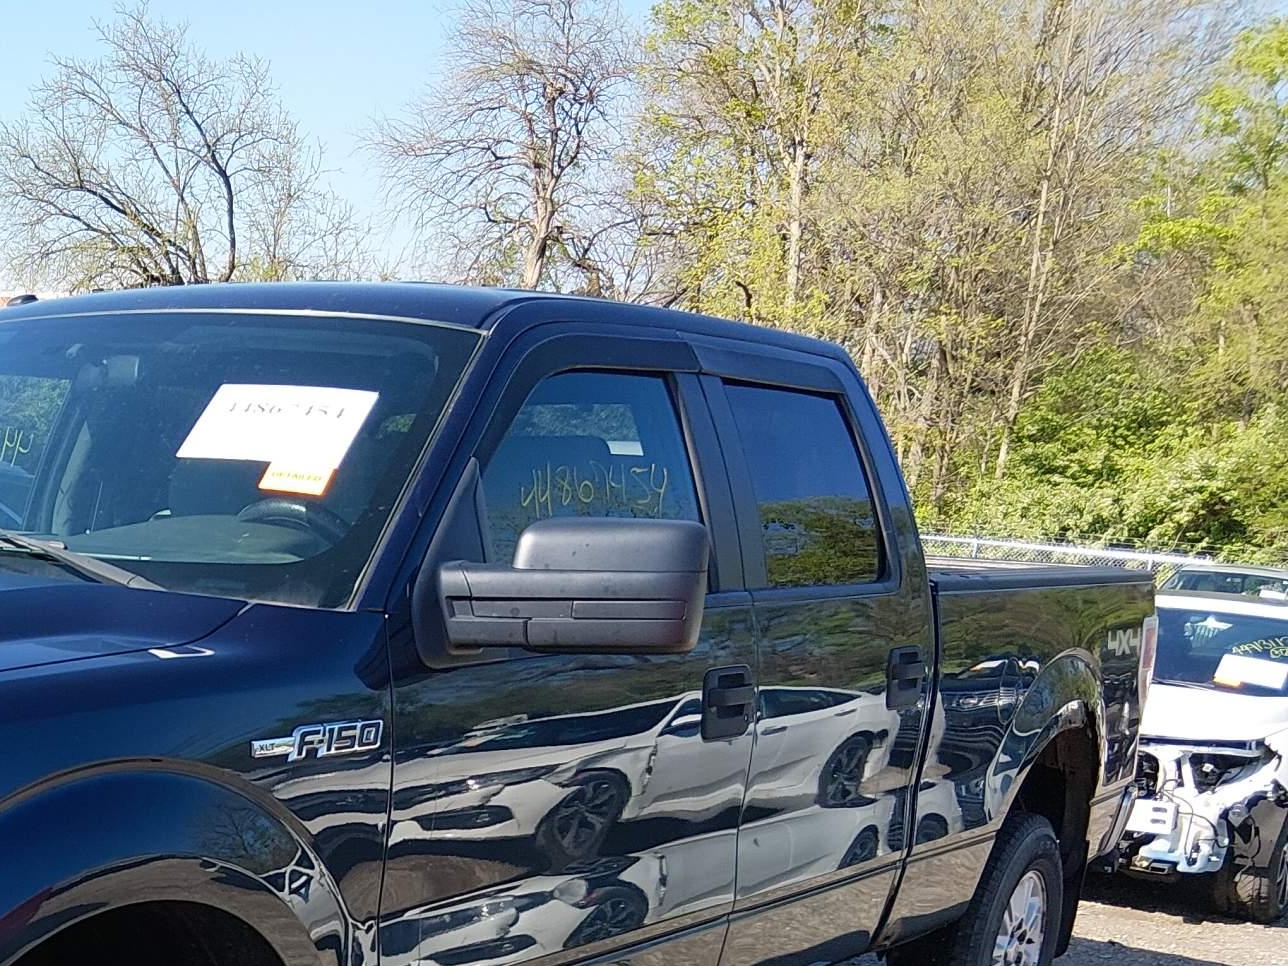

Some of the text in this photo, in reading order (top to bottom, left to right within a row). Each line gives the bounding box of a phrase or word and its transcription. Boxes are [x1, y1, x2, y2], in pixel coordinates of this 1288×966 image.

[520, 460, 668, 518] 44867454
[1107, 629, 1141, 656] 4X4
[259, 743, 275, 752] XLT
